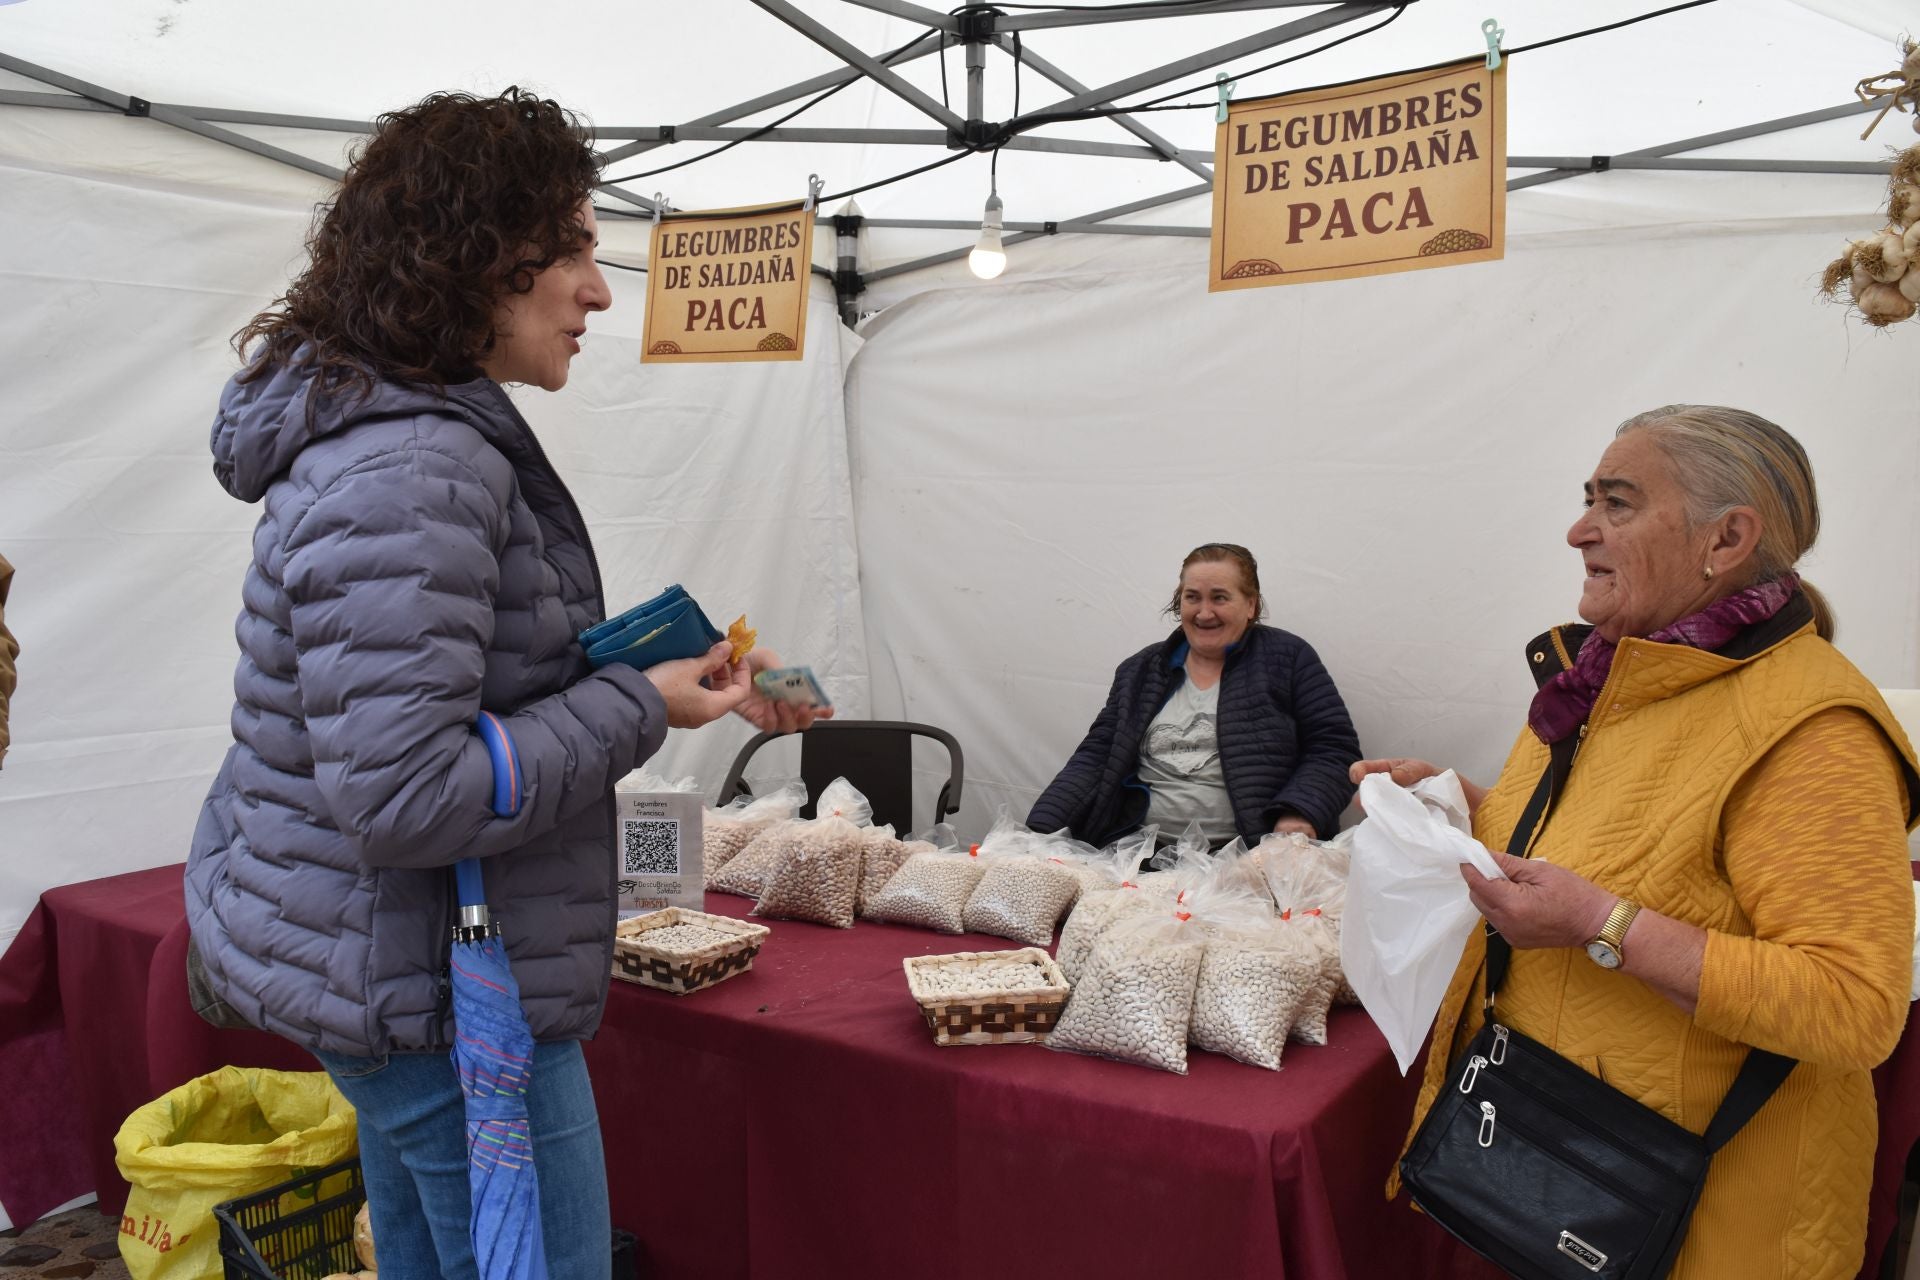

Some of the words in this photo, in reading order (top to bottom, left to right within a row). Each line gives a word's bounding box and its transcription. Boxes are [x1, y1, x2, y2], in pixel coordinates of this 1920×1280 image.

[1235, 82, 1483, 155] LEGUMBRES
[1244, 160, 1290, 194] DE
[1304, 128, 1480, 187] SALDAÑA
[1285, 186, 1434, 244] PACA
[660, 221, 801, 259] LEGUMBRES
[664, 265, 691, 290] DE
[698, 254, 796, 288] SALDAÑA
[684, 296, 767, 332] PACA
[633, 800, 668, 809] Legumbres
